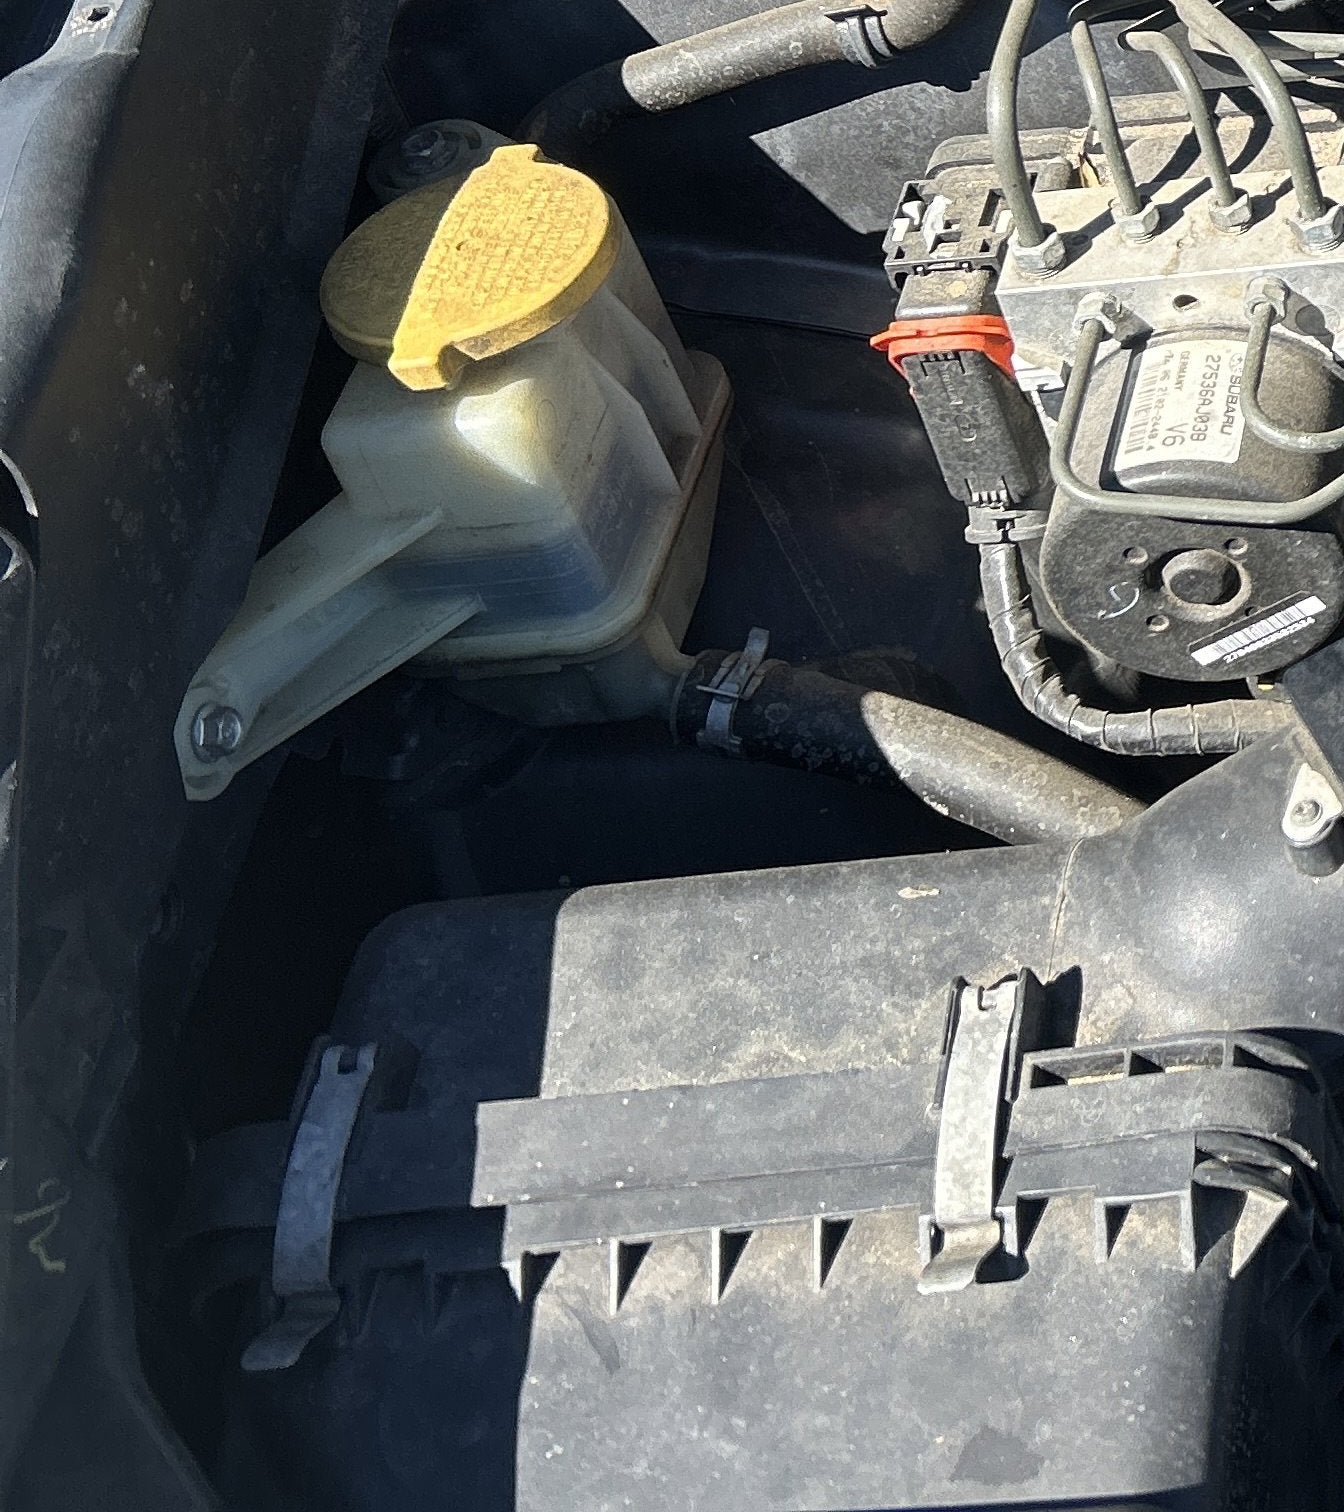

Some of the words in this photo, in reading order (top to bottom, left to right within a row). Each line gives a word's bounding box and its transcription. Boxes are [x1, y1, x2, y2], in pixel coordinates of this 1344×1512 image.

[1173, 350, 1191, 392] GERMANY
[1220, 374, 1242, 436] SUBARU
[1161, 422, 1189, 447] V6
